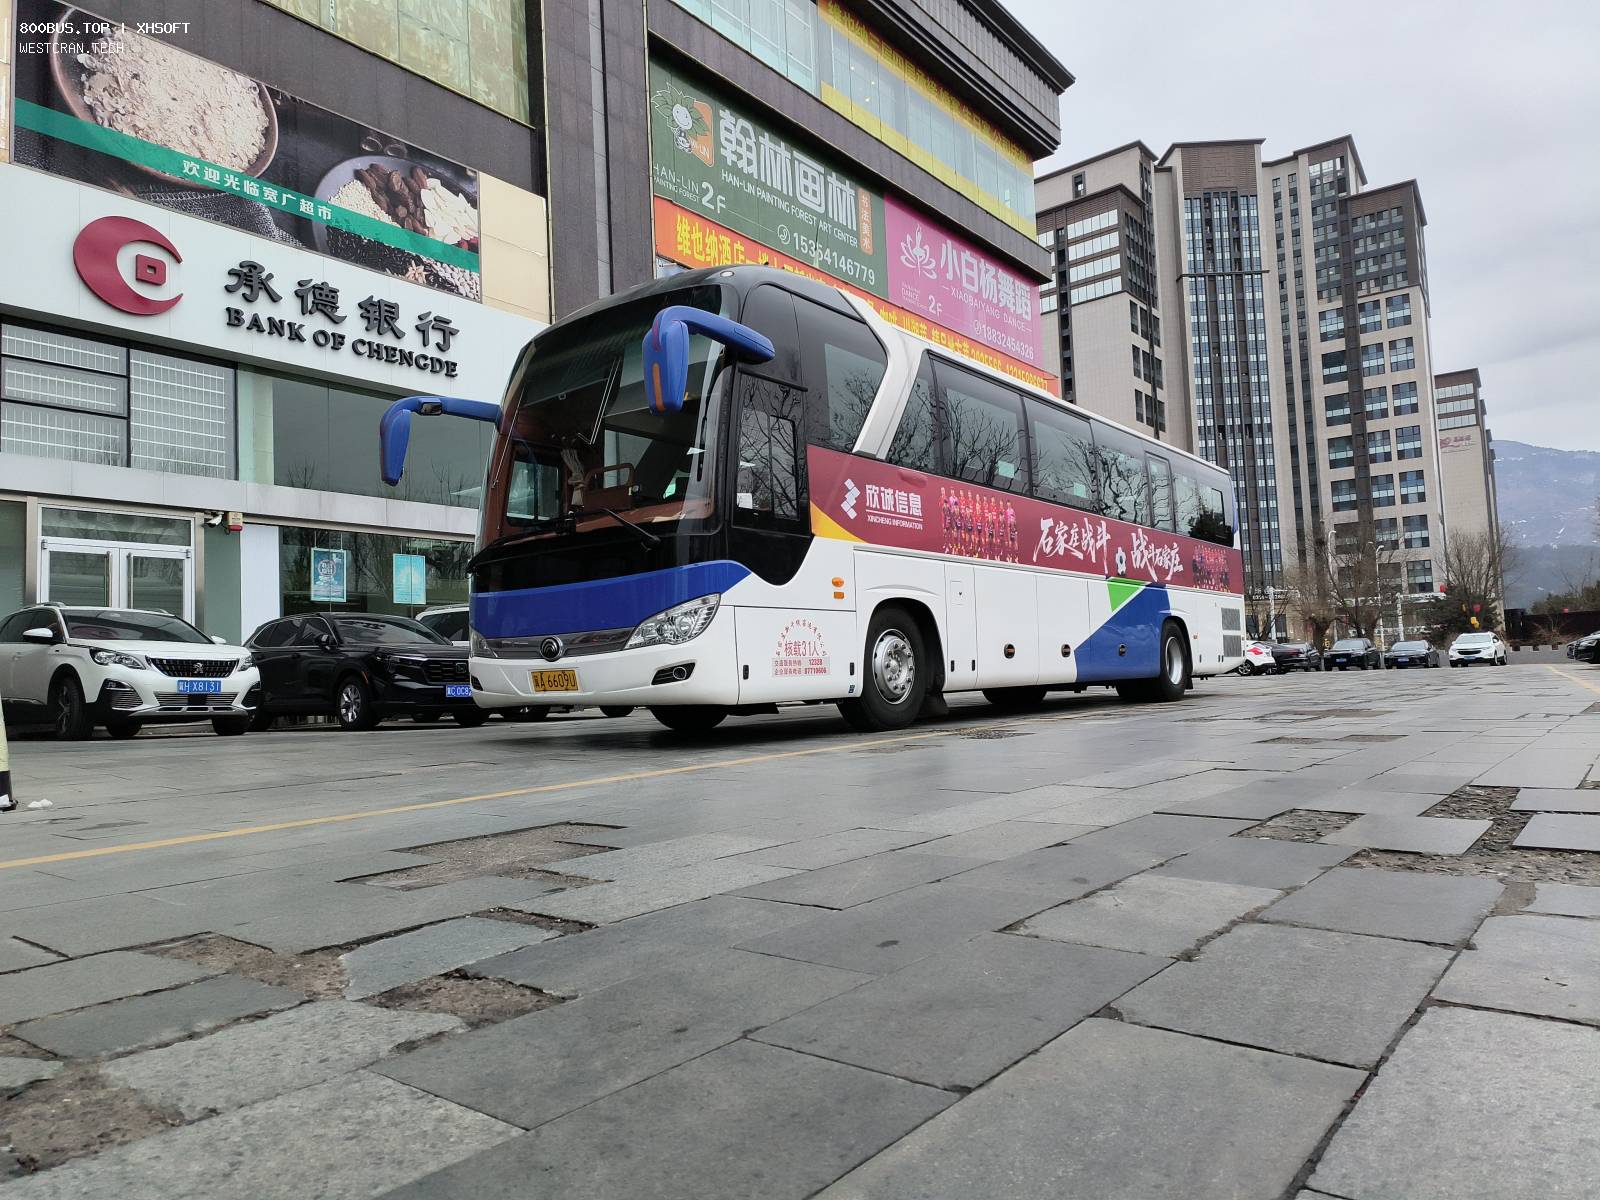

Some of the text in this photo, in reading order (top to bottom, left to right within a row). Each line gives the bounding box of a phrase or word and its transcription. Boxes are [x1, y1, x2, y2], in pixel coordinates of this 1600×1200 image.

[182, 159, 332, 221] 欢迎光临宽广超市
[701, 181, 727, 214] 2F
[719, 109, 857, 232] 翰林画林
[721, 168, 858, 248] HAN-LIN PAINTING FOREST ART CENTER
[793, 231, 876, 286] 15354146779
[940, 239, 1032, 320] 小白杨舞蹈
[224, 260, 460, 352] 承德银行
[928, 295, 943, 318] 2F
[951, 287, 1001, 319] XIAOBAIYANG
[1003, 313, 1026, 332] DANCE
[225, 306, 459, 378] BANK OF CHENGDE
[865, 484, 923, 517] 欣诚信息
[867, 514, 924, 531] XINCHENG INFORMATION
